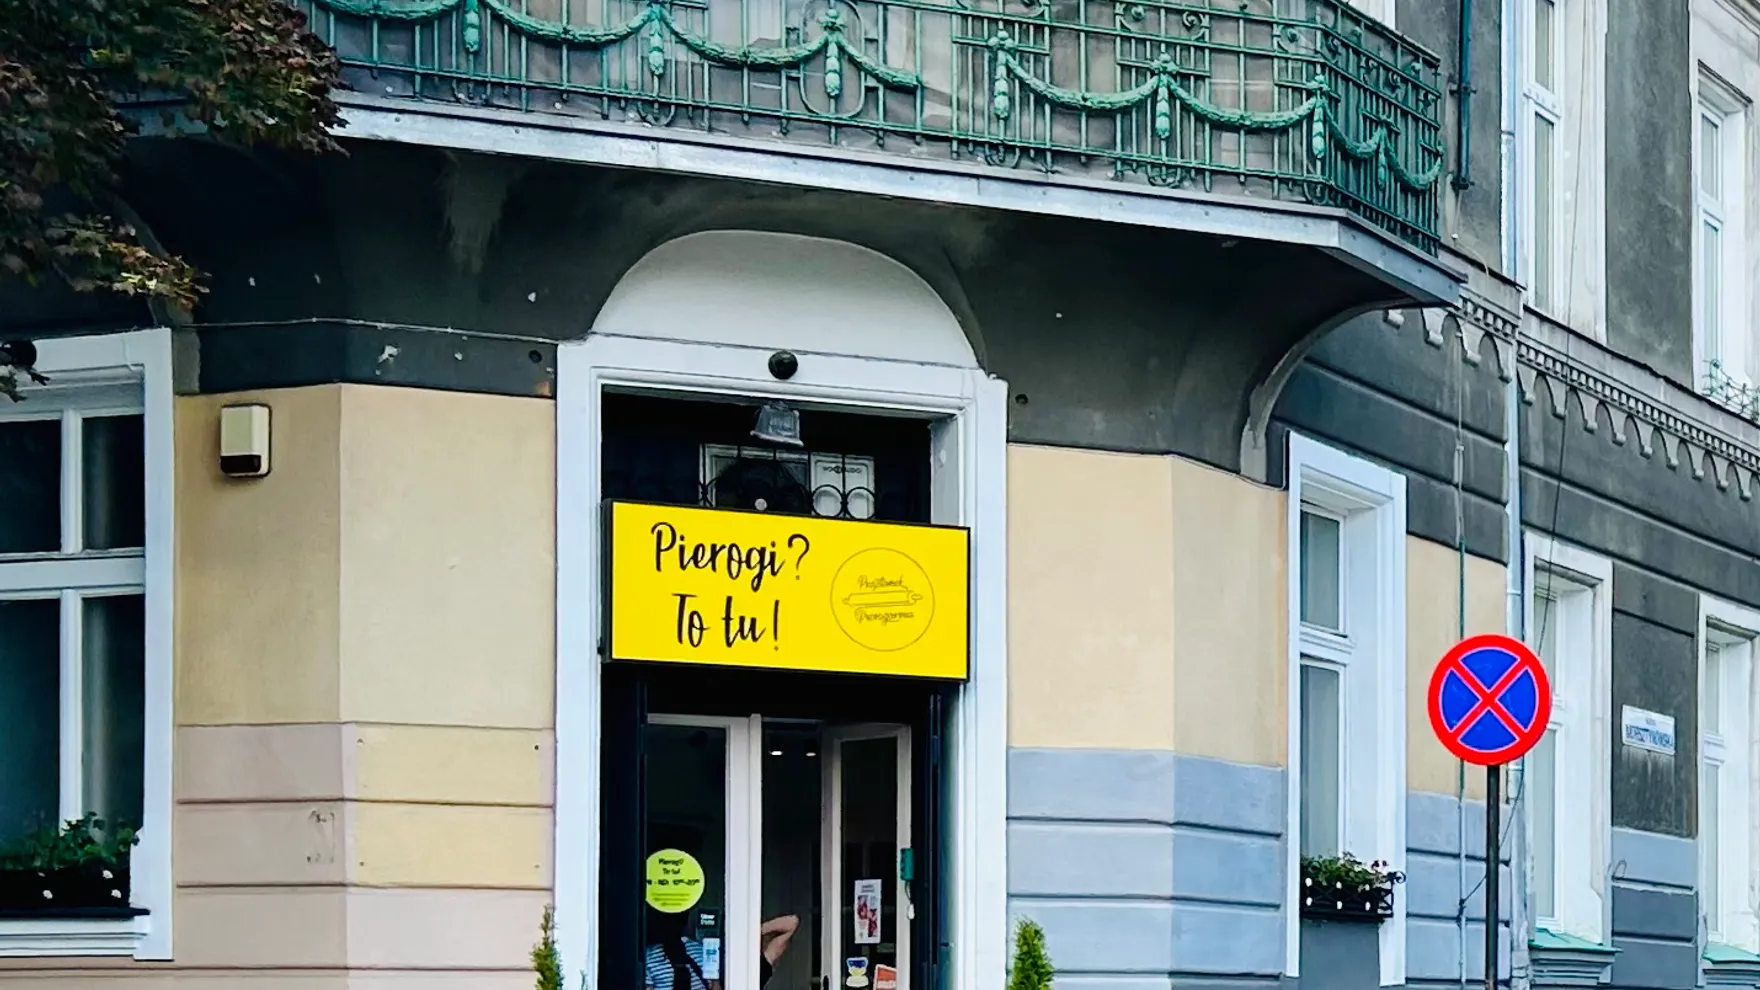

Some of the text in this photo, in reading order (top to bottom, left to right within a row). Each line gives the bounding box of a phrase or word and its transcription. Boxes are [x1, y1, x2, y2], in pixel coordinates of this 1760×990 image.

[651, 522, 810, 592] Pierogi?
[672, 593, 780, 651] To tu!
